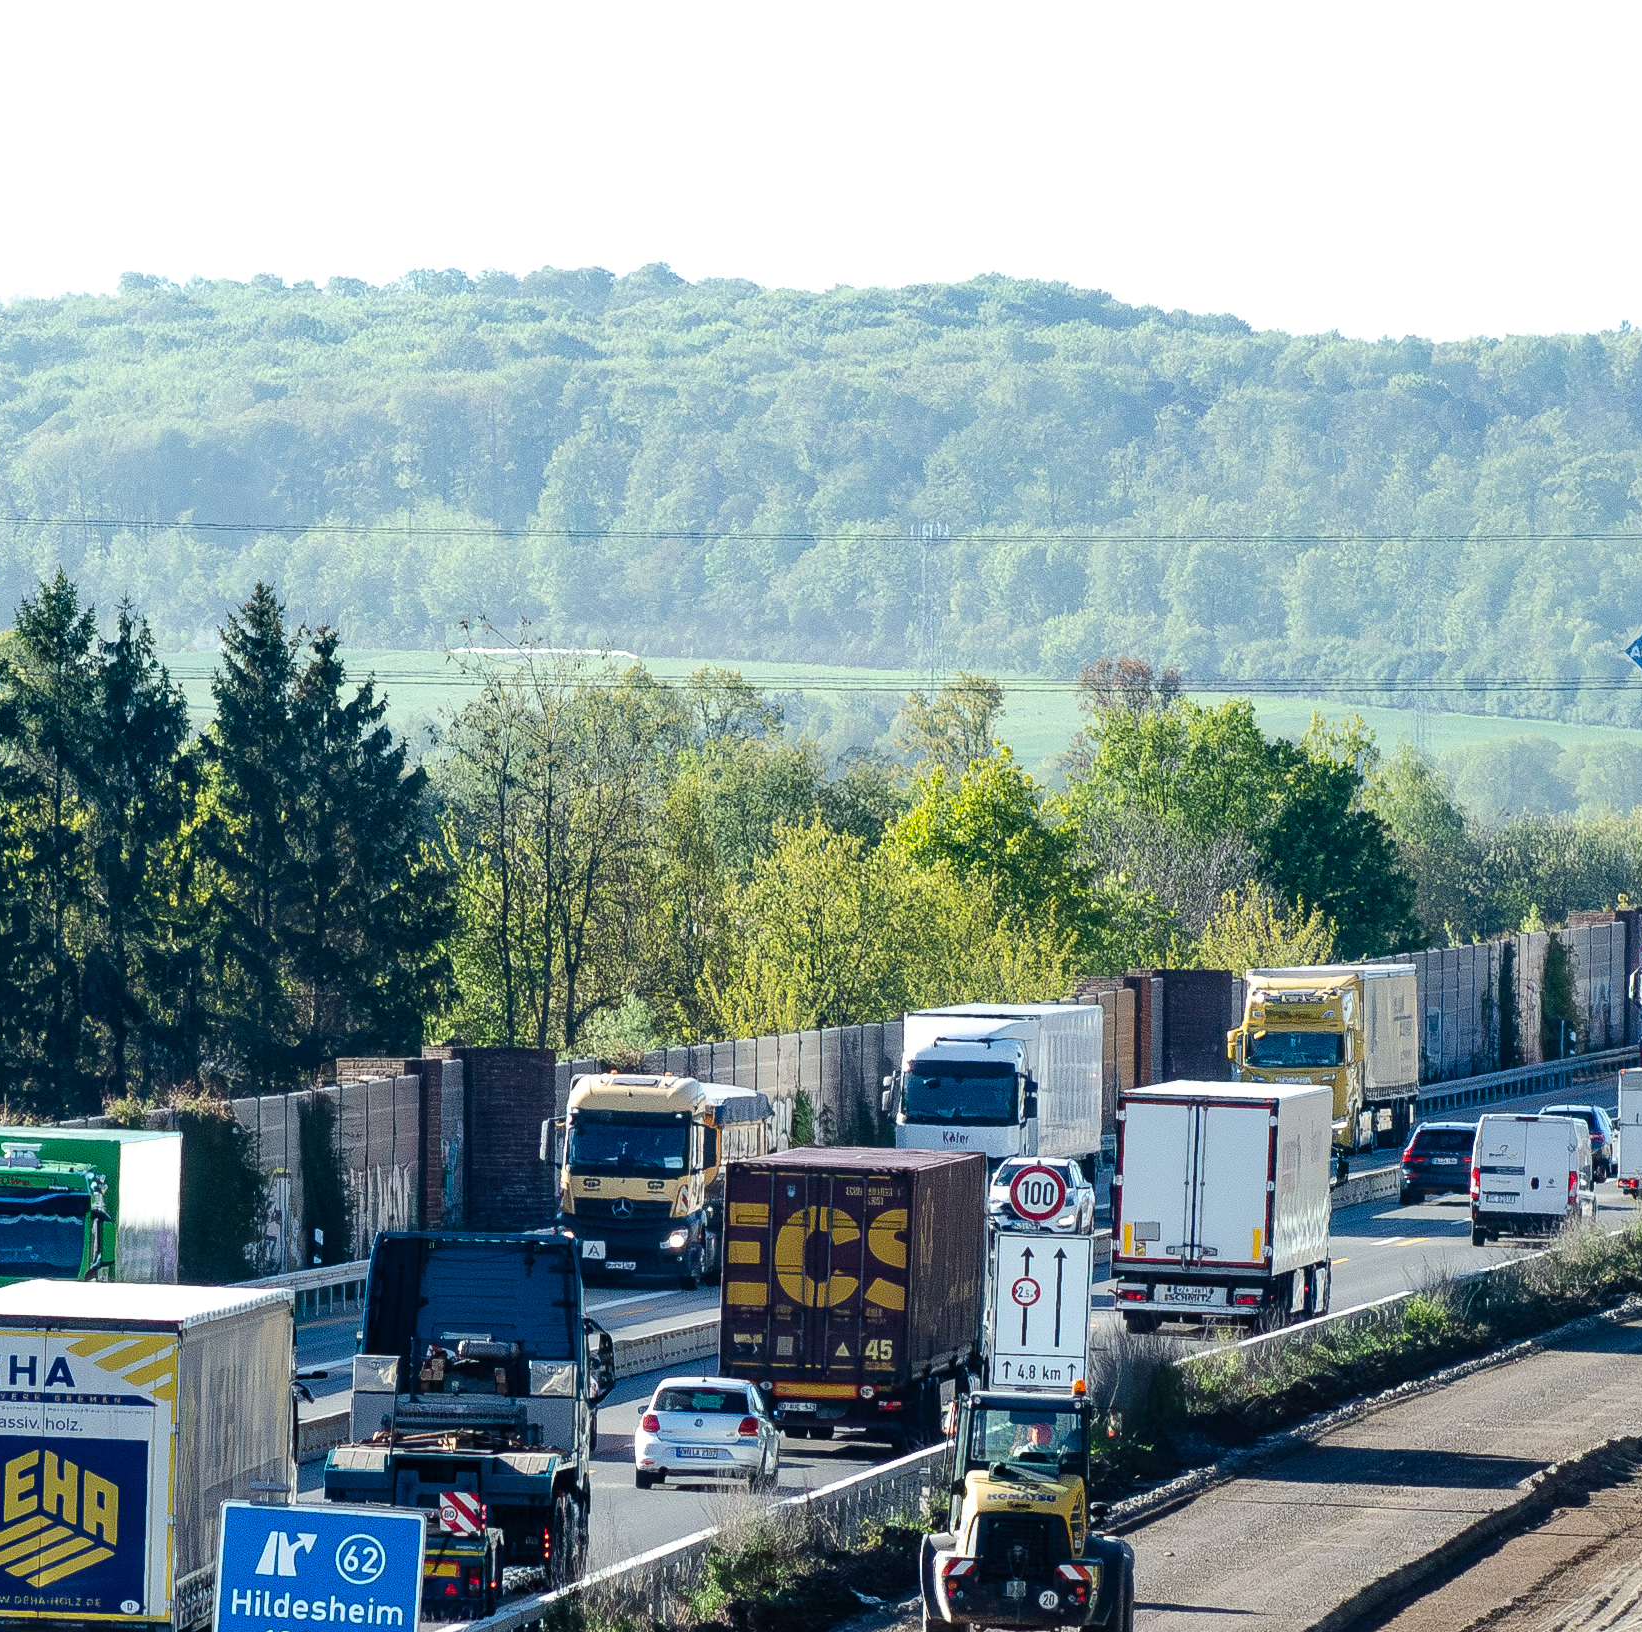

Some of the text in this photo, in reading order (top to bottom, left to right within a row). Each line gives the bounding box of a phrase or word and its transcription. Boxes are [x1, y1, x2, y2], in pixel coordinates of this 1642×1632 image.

[1022, 1181, 1055, 1206] 100
[588, 1244, 600, 1256] A
[864, 1339, 893, 1360] 45
[1018, 1364, 1061, 1380] 4,8 km
[45, 1417, 84, 1433] holz.
[343, 1545, 379, 1574] 62
[231, 1588, 404, 1626] Hildesheim
[1042, 1593, 1055, 1606] 20
